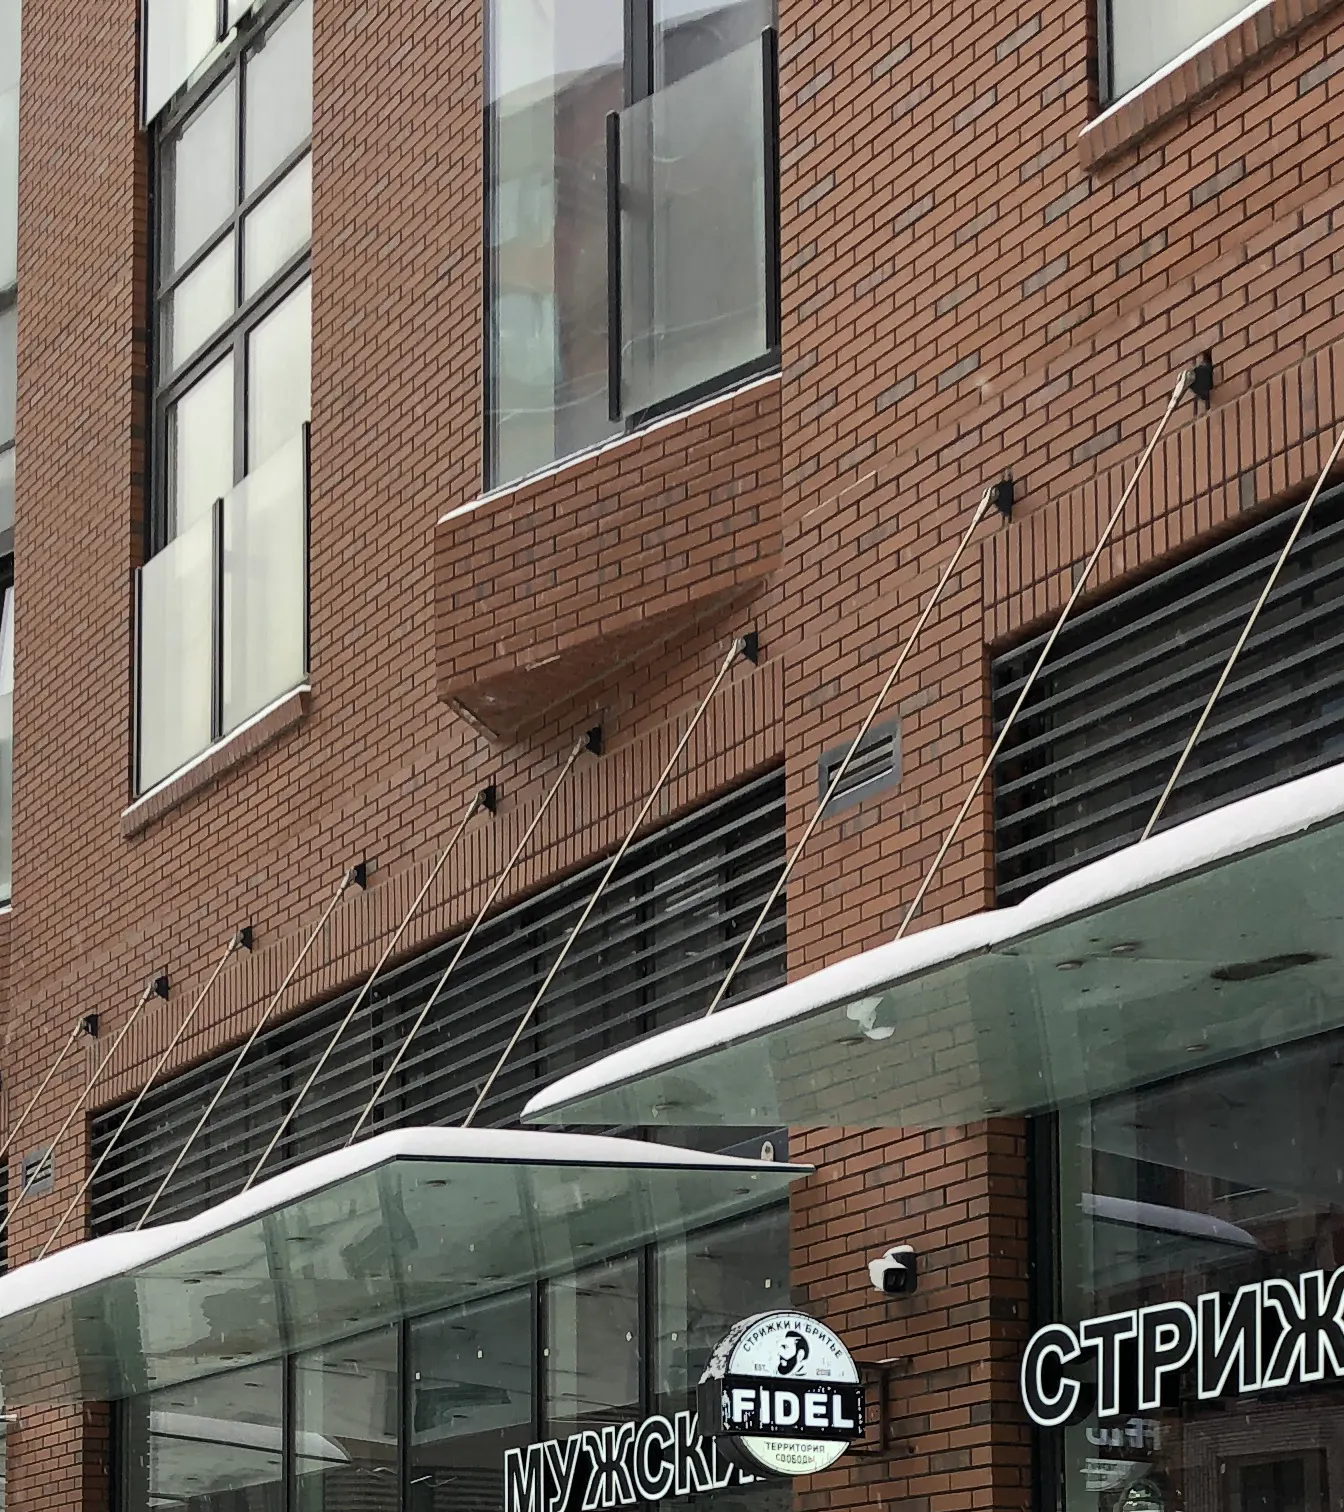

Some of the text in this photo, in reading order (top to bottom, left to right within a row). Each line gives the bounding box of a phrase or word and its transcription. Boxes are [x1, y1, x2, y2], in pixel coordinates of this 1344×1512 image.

[743, 1321, 843, 1359] СТРИЖКИ И БРИТЬЕ
[731, 1388, 855, 1429] FIDEL
[765, 1441, 825, 1454] ТЕРРИТОРИЯ
